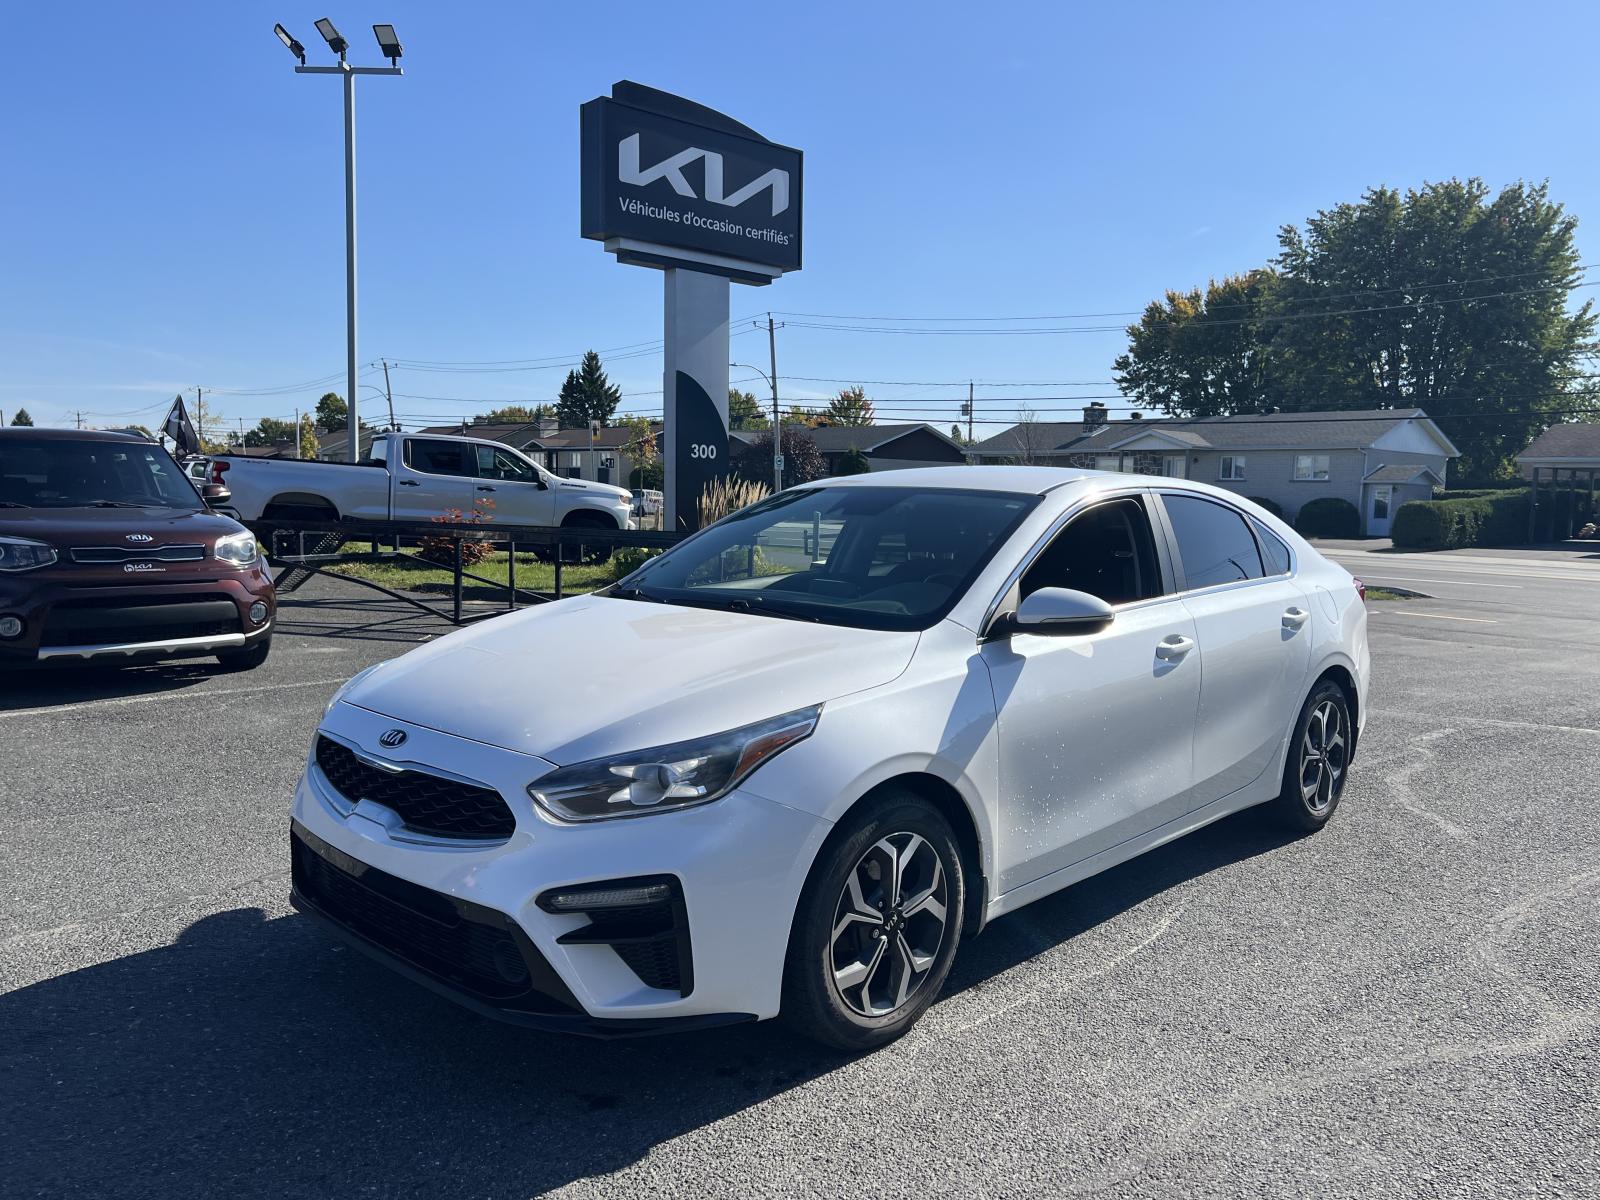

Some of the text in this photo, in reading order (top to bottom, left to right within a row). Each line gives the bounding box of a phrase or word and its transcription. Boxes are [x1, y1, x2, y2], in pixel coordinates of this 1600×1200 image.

[618, 132, 790, 217] KIA
[618, 196, 789, 245] Véhicules d'occasion certifiés
[690, 443, 717, 459] 300
[381, 730, 404, 745] KIA
